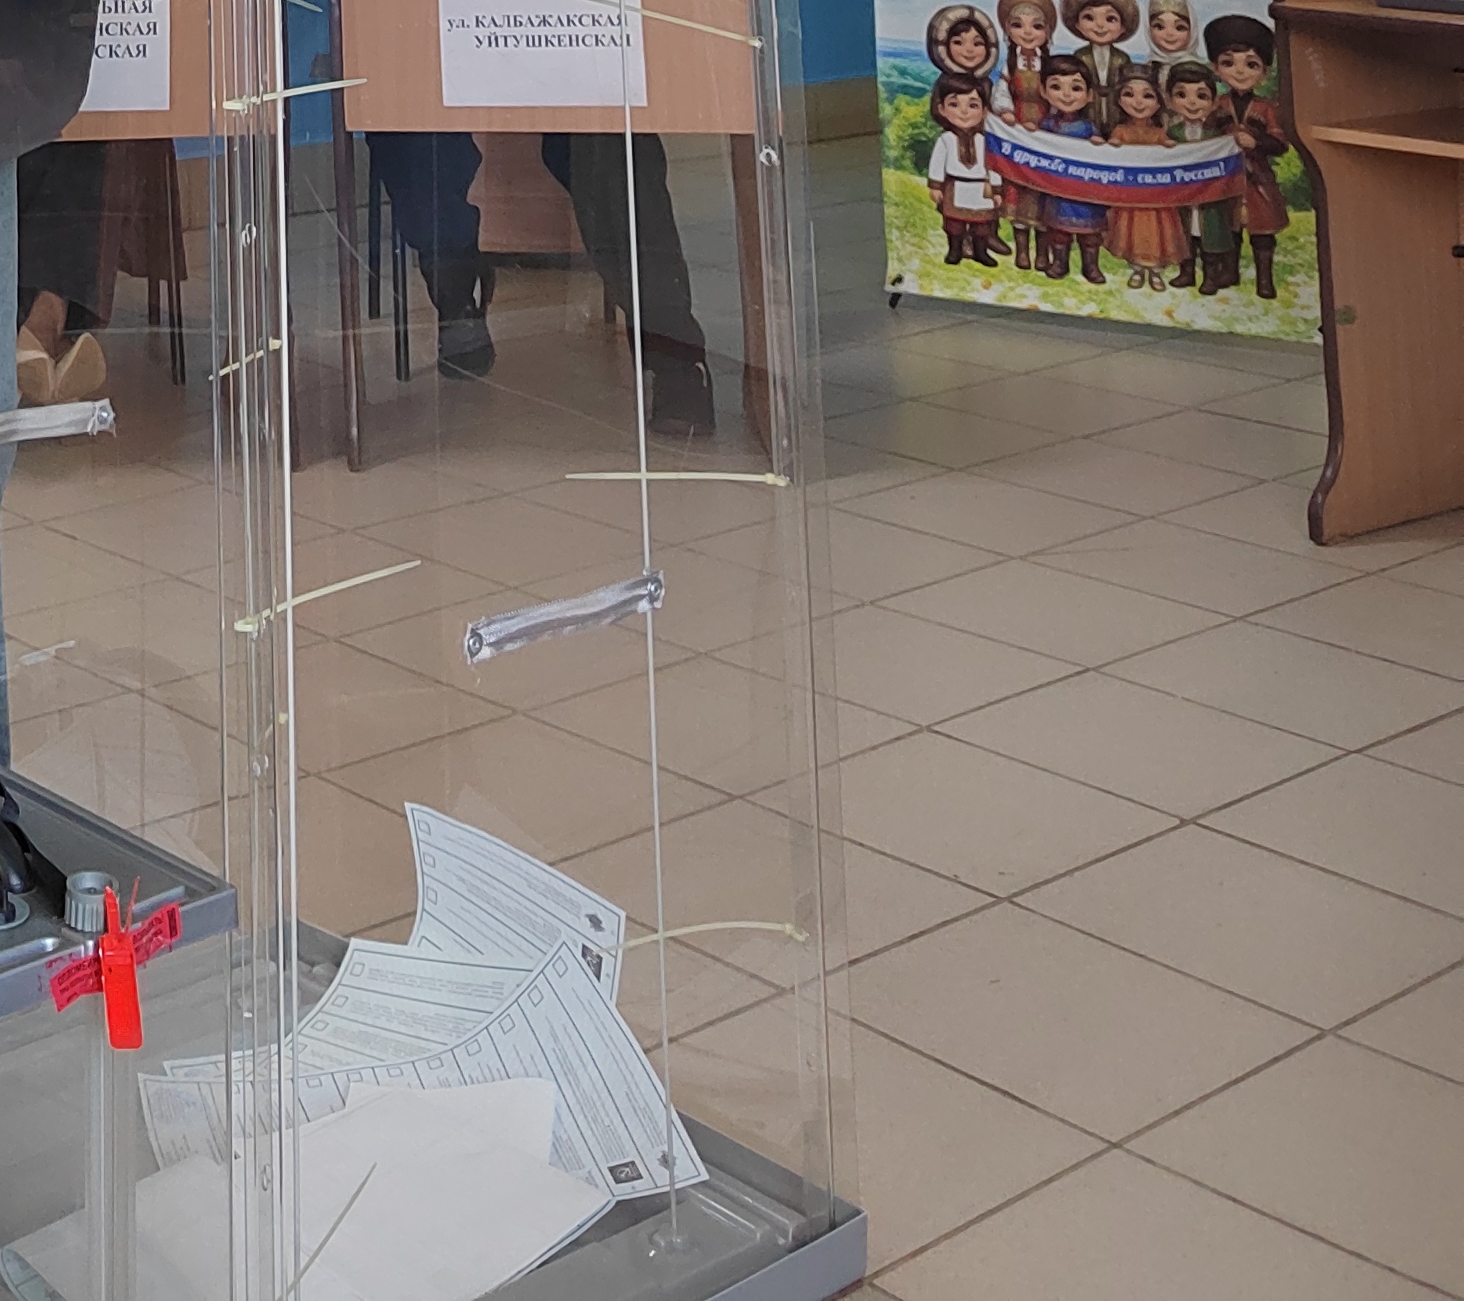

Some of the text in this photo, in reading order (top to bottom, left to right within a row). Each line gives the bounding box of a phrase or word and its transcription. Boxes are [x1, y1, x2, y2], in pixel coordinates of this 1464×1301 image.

[102, 0, 153, 14] ЬНАЯ
[447, 13, 628, 32] ул. КАЛБАЖАКСКАЯ
[474, 31, 632, 49] УЙТУШКЕНСКАЯ
[95, 43, 147, 59] СКАЯ
[1001, 142, 1012, 155] В
[1013, 150, 1066, 173] дружбе
[1067, 165, 1125, 184] народов
[1136, 173, 1172, 184] сила
[1173, 161, 1226, 183] России!
